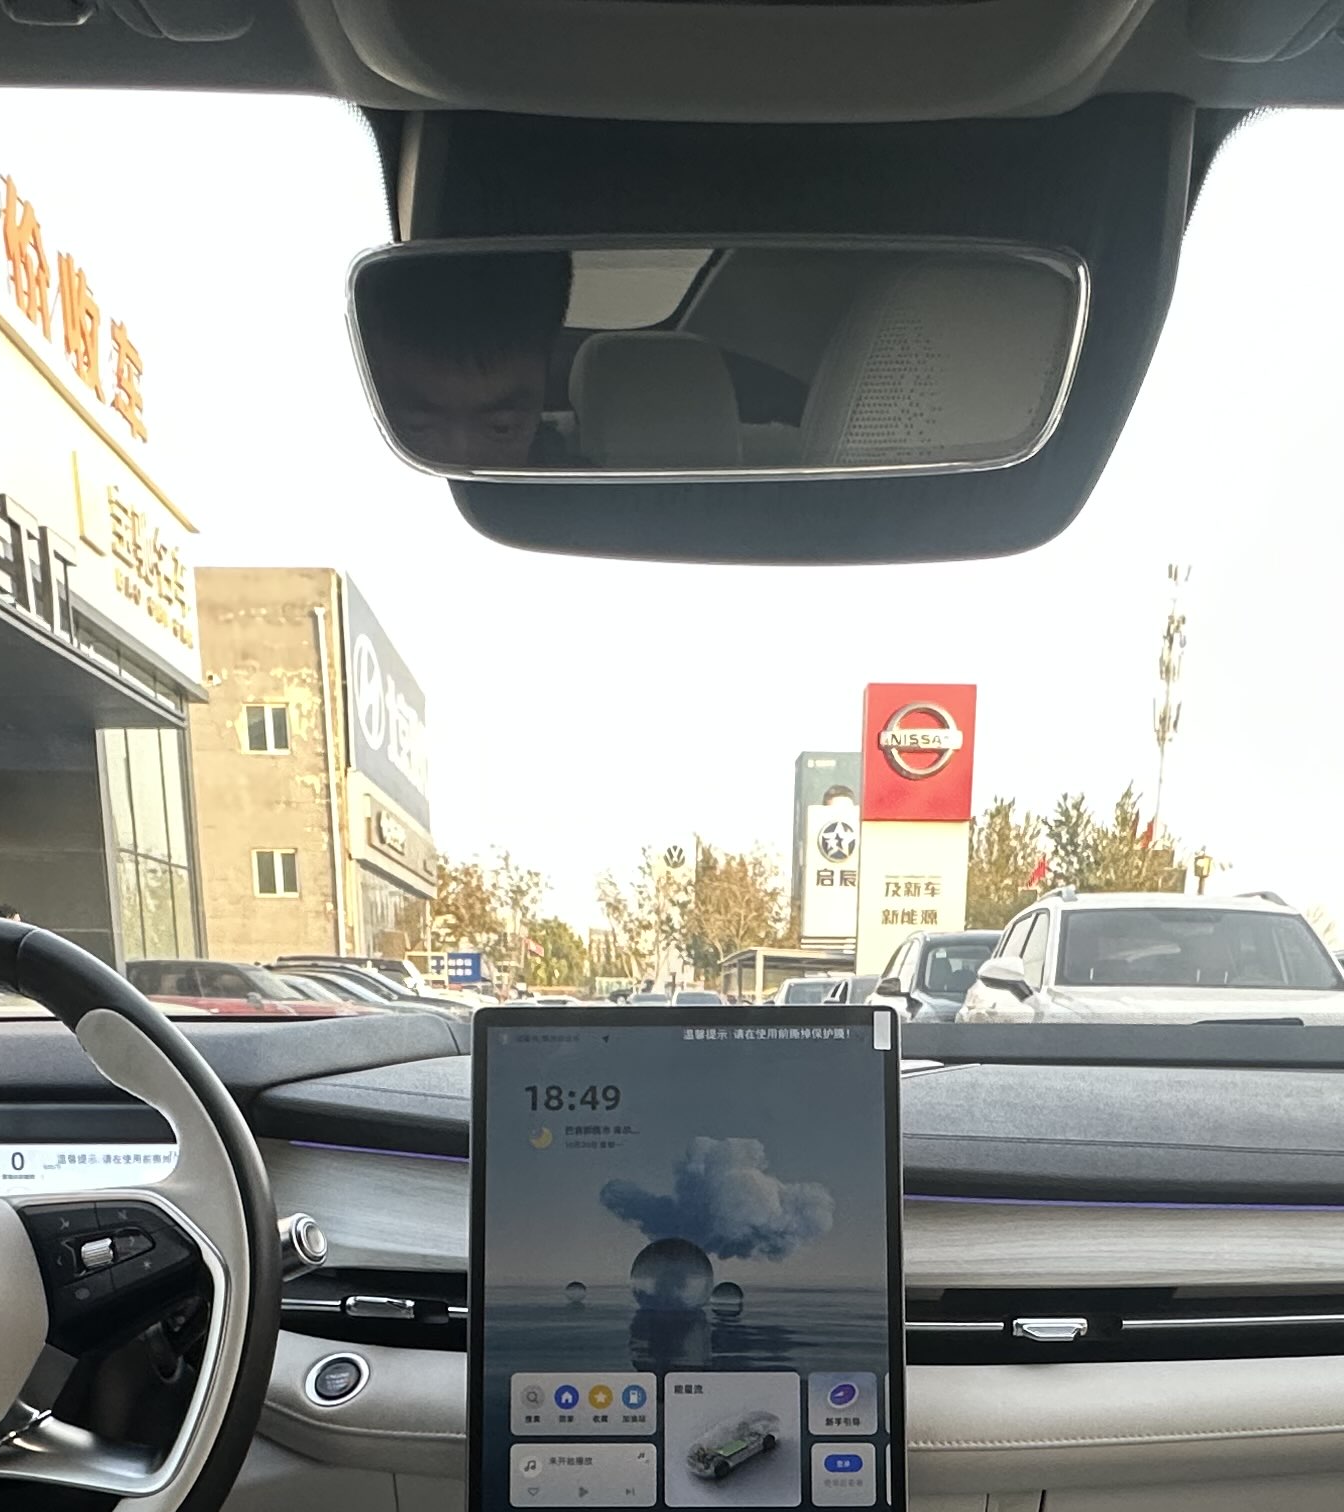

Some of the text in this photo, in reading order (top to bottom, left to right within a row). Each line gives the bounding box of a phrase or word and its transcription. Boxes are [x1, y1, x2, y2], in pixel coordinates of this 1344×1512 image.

[890, 733, 951, 746] NISSA
[816, 869, 857, 887] 启辰
[881, 908, 938, 925] 新能源
[525, 1085, 622, 1111] 18:49
[11, 1151, 25, 1171] 0
